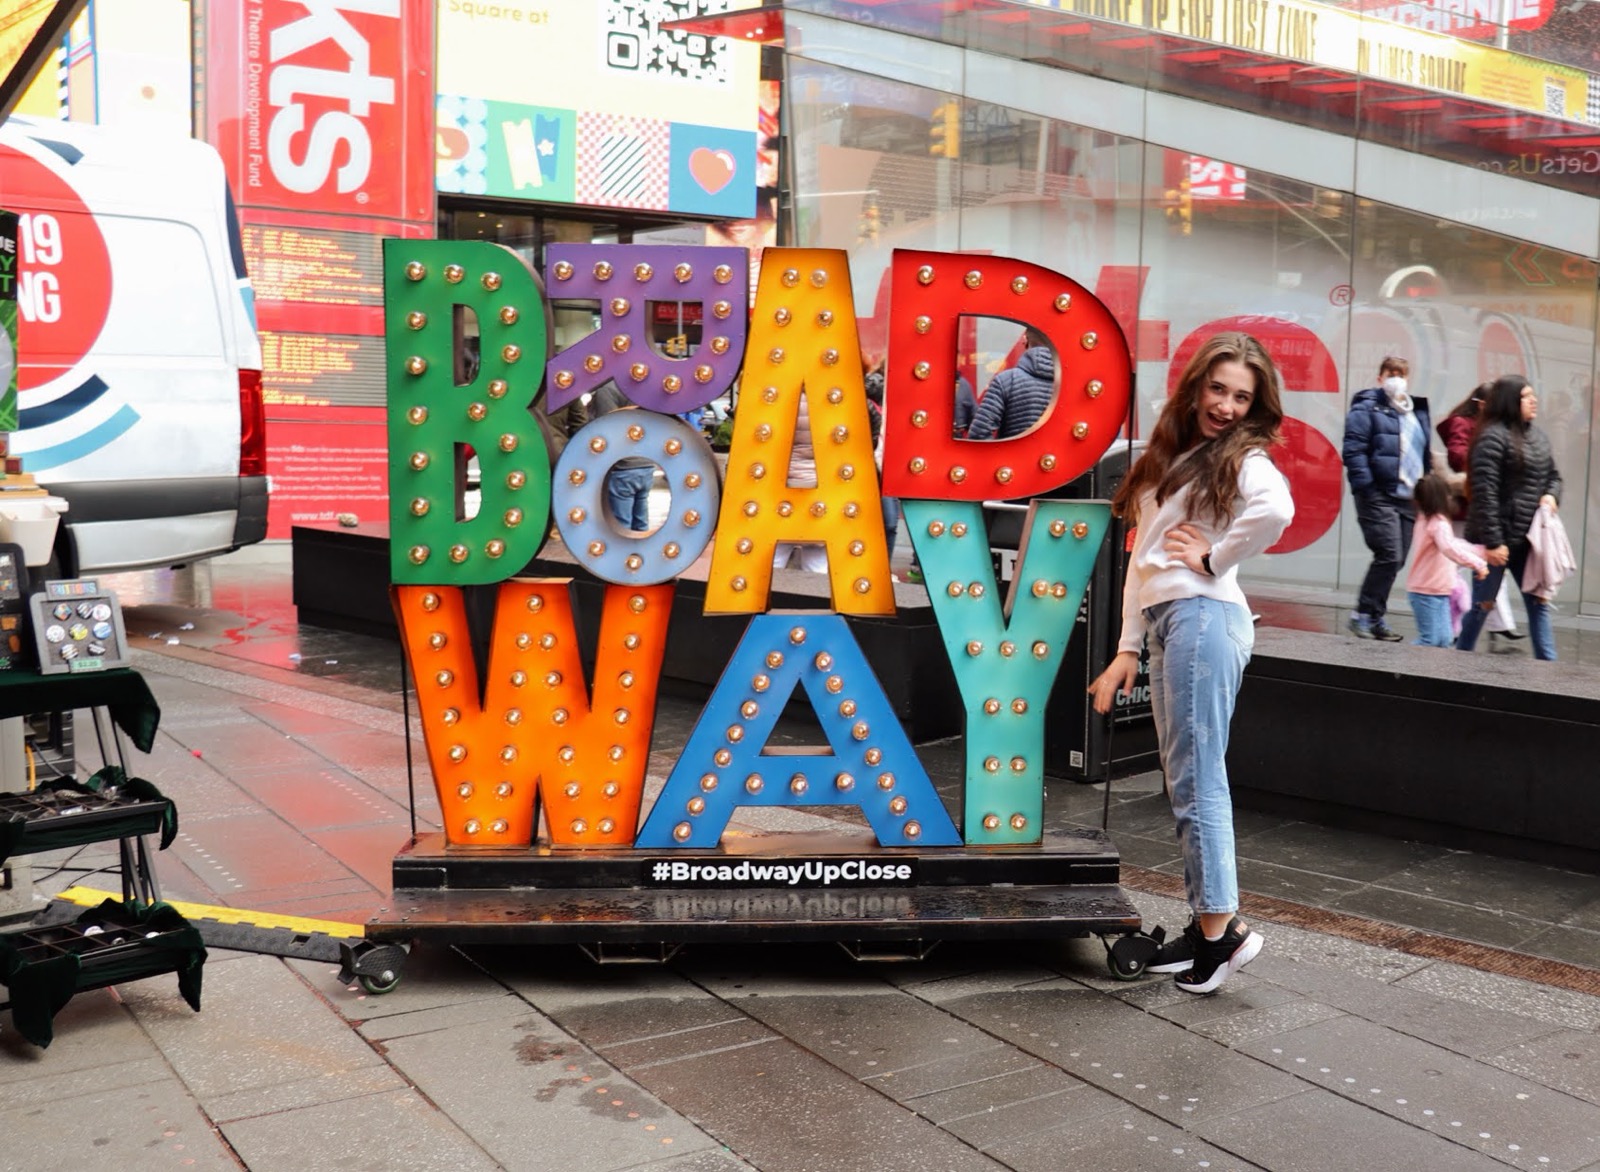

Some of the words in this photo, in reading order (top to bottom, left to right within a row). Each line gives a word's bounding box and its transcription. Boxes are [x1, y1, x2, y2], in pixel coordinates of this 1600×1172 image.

[449, 0, 523, 21] Square
[529, 10, 549, 23] at
[249, 8, 263, 58] Theatre
[246, 63, 263, 150] Development
[249, 154, 263, 187] Fund
[651, 861, 912, 885] #BroadwayUpClose
